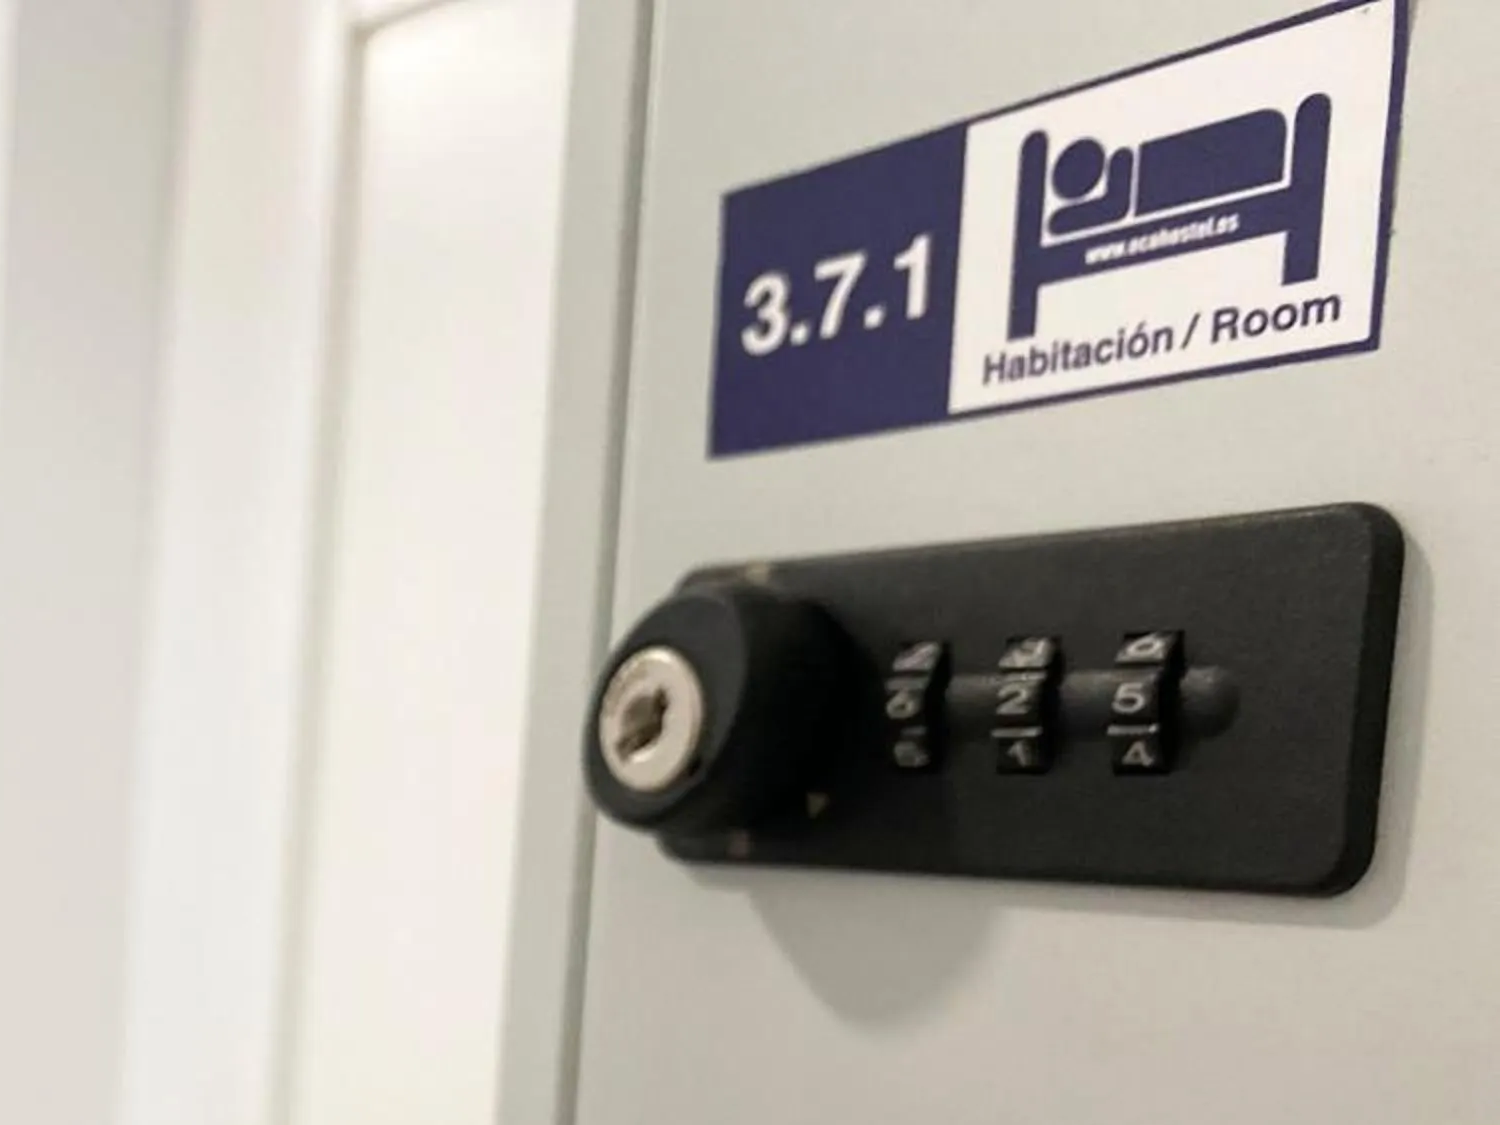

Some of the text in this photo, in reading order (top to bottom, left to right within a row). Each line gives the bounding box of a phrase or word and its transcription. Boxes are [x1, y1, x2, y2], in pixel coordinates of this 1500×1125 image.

[740, 233, 930, 356] 3.7.1
[982, 293, 1343, 387] Habitación / Room
[1111, 681, 1146, 714] 5
